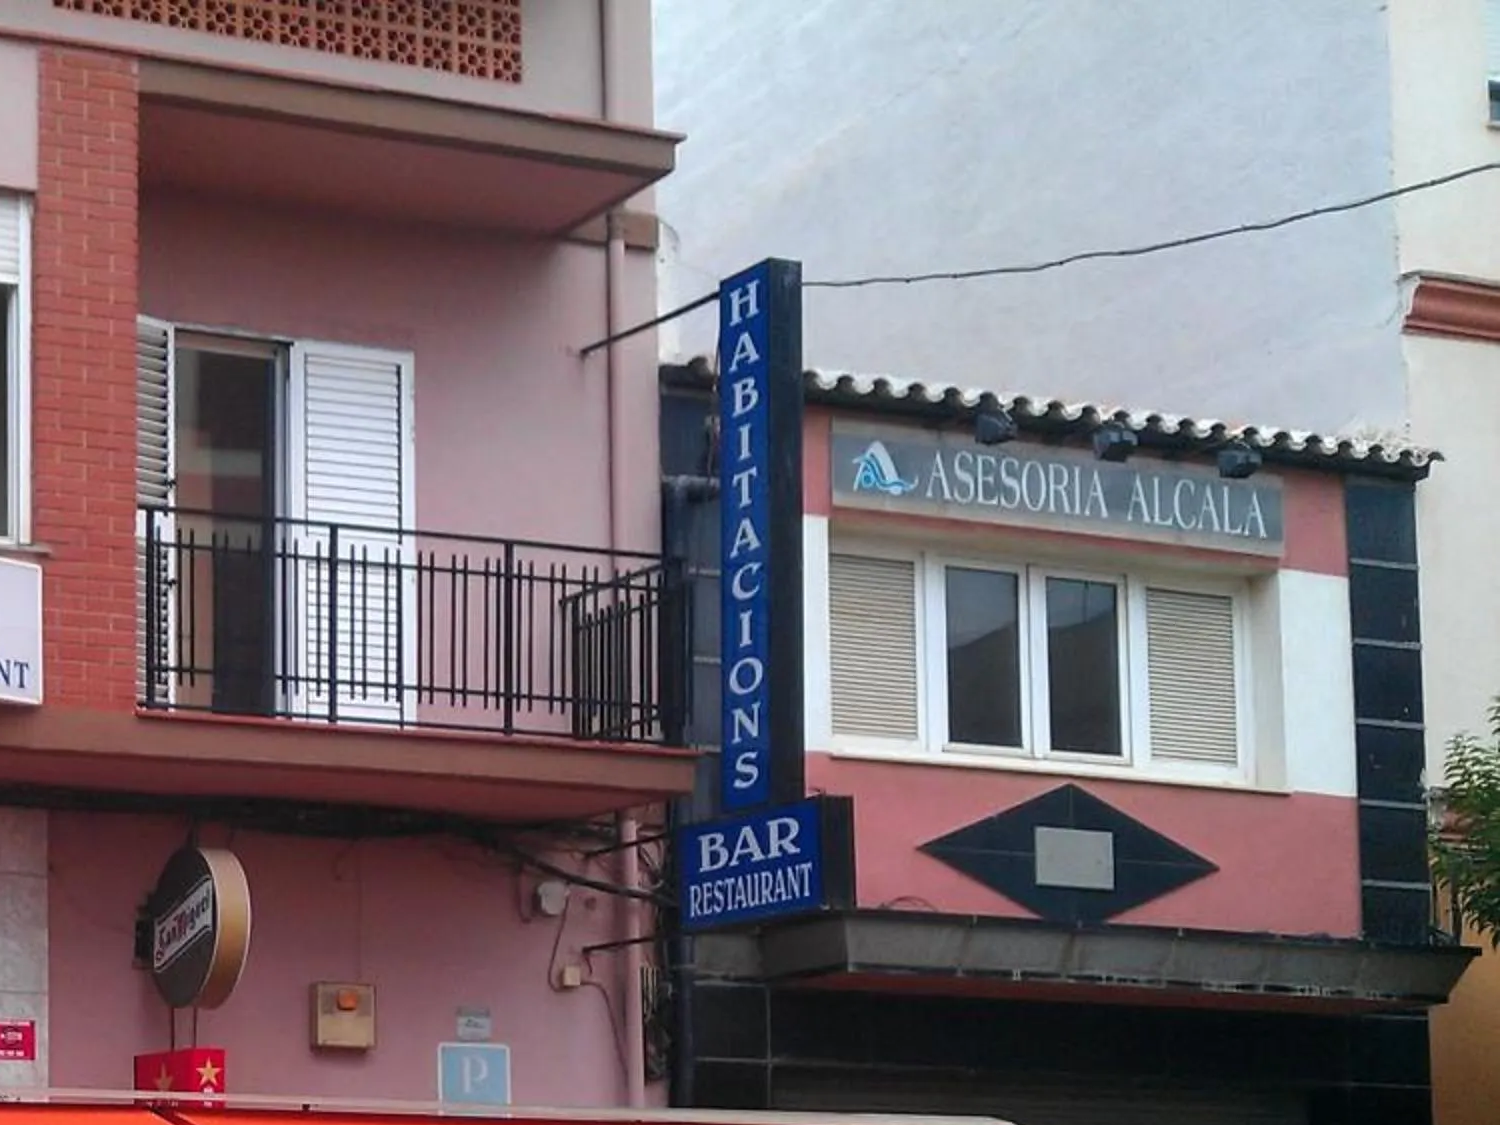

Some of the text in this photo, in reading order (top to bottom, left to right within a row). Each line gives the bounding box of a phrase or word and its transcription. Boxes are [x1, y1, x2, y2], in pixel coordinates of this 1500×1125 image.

[925, 451, 1268, 539] ASESORIA ALCALA
[729, 279, 762, 789] HABITACIONS
[698, 817, 802, 873] BAR
[689, 862, 814, 918] RESTAURANT
